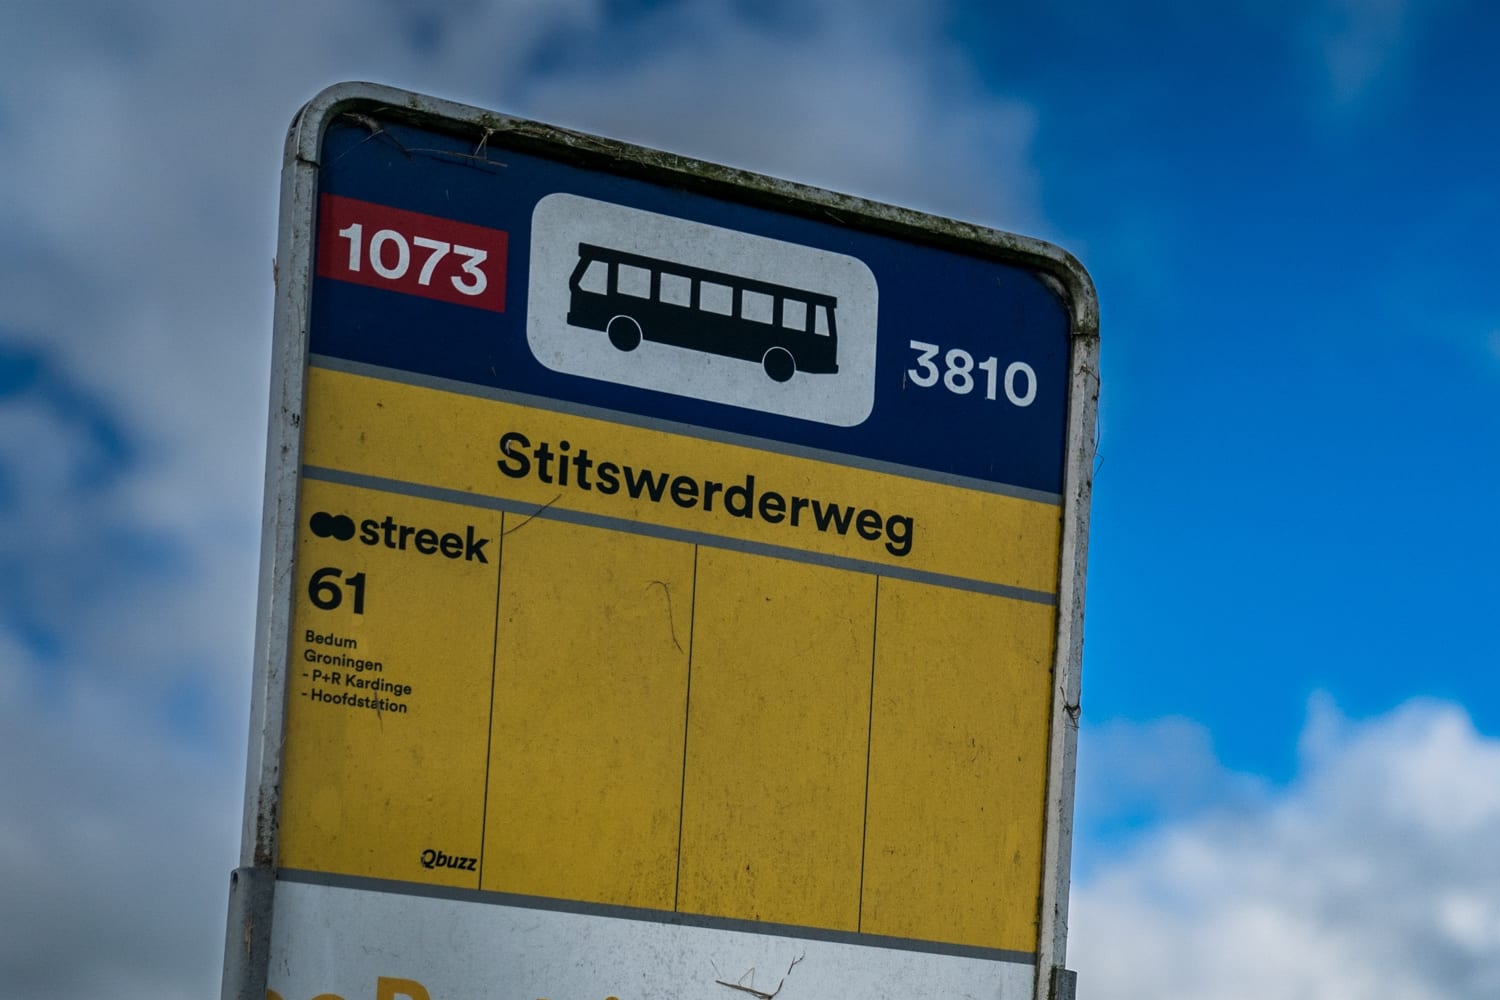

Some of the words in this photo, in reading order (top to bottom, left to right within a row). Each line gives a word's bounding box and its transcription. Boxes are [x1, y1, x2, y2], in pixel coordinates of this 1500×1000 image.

[338, 222, 489, 297] 1073
[906, 339, 1039, 408] 3810
[497, 431, 915, 558] Stitswerderweg
[359, 515, 490, 565] streek
[308, 566, 367, 615] 61
[305, 630, 357, 649] Bedum
[304, 650, 383, 672] Groningen
[311, 688, 408, 714] Hoofdstation
[312, 669, 342, 686] P+R
[345, 672, 412, 697] Kardinge
[420, 848, 477, 872] Qbuzz
